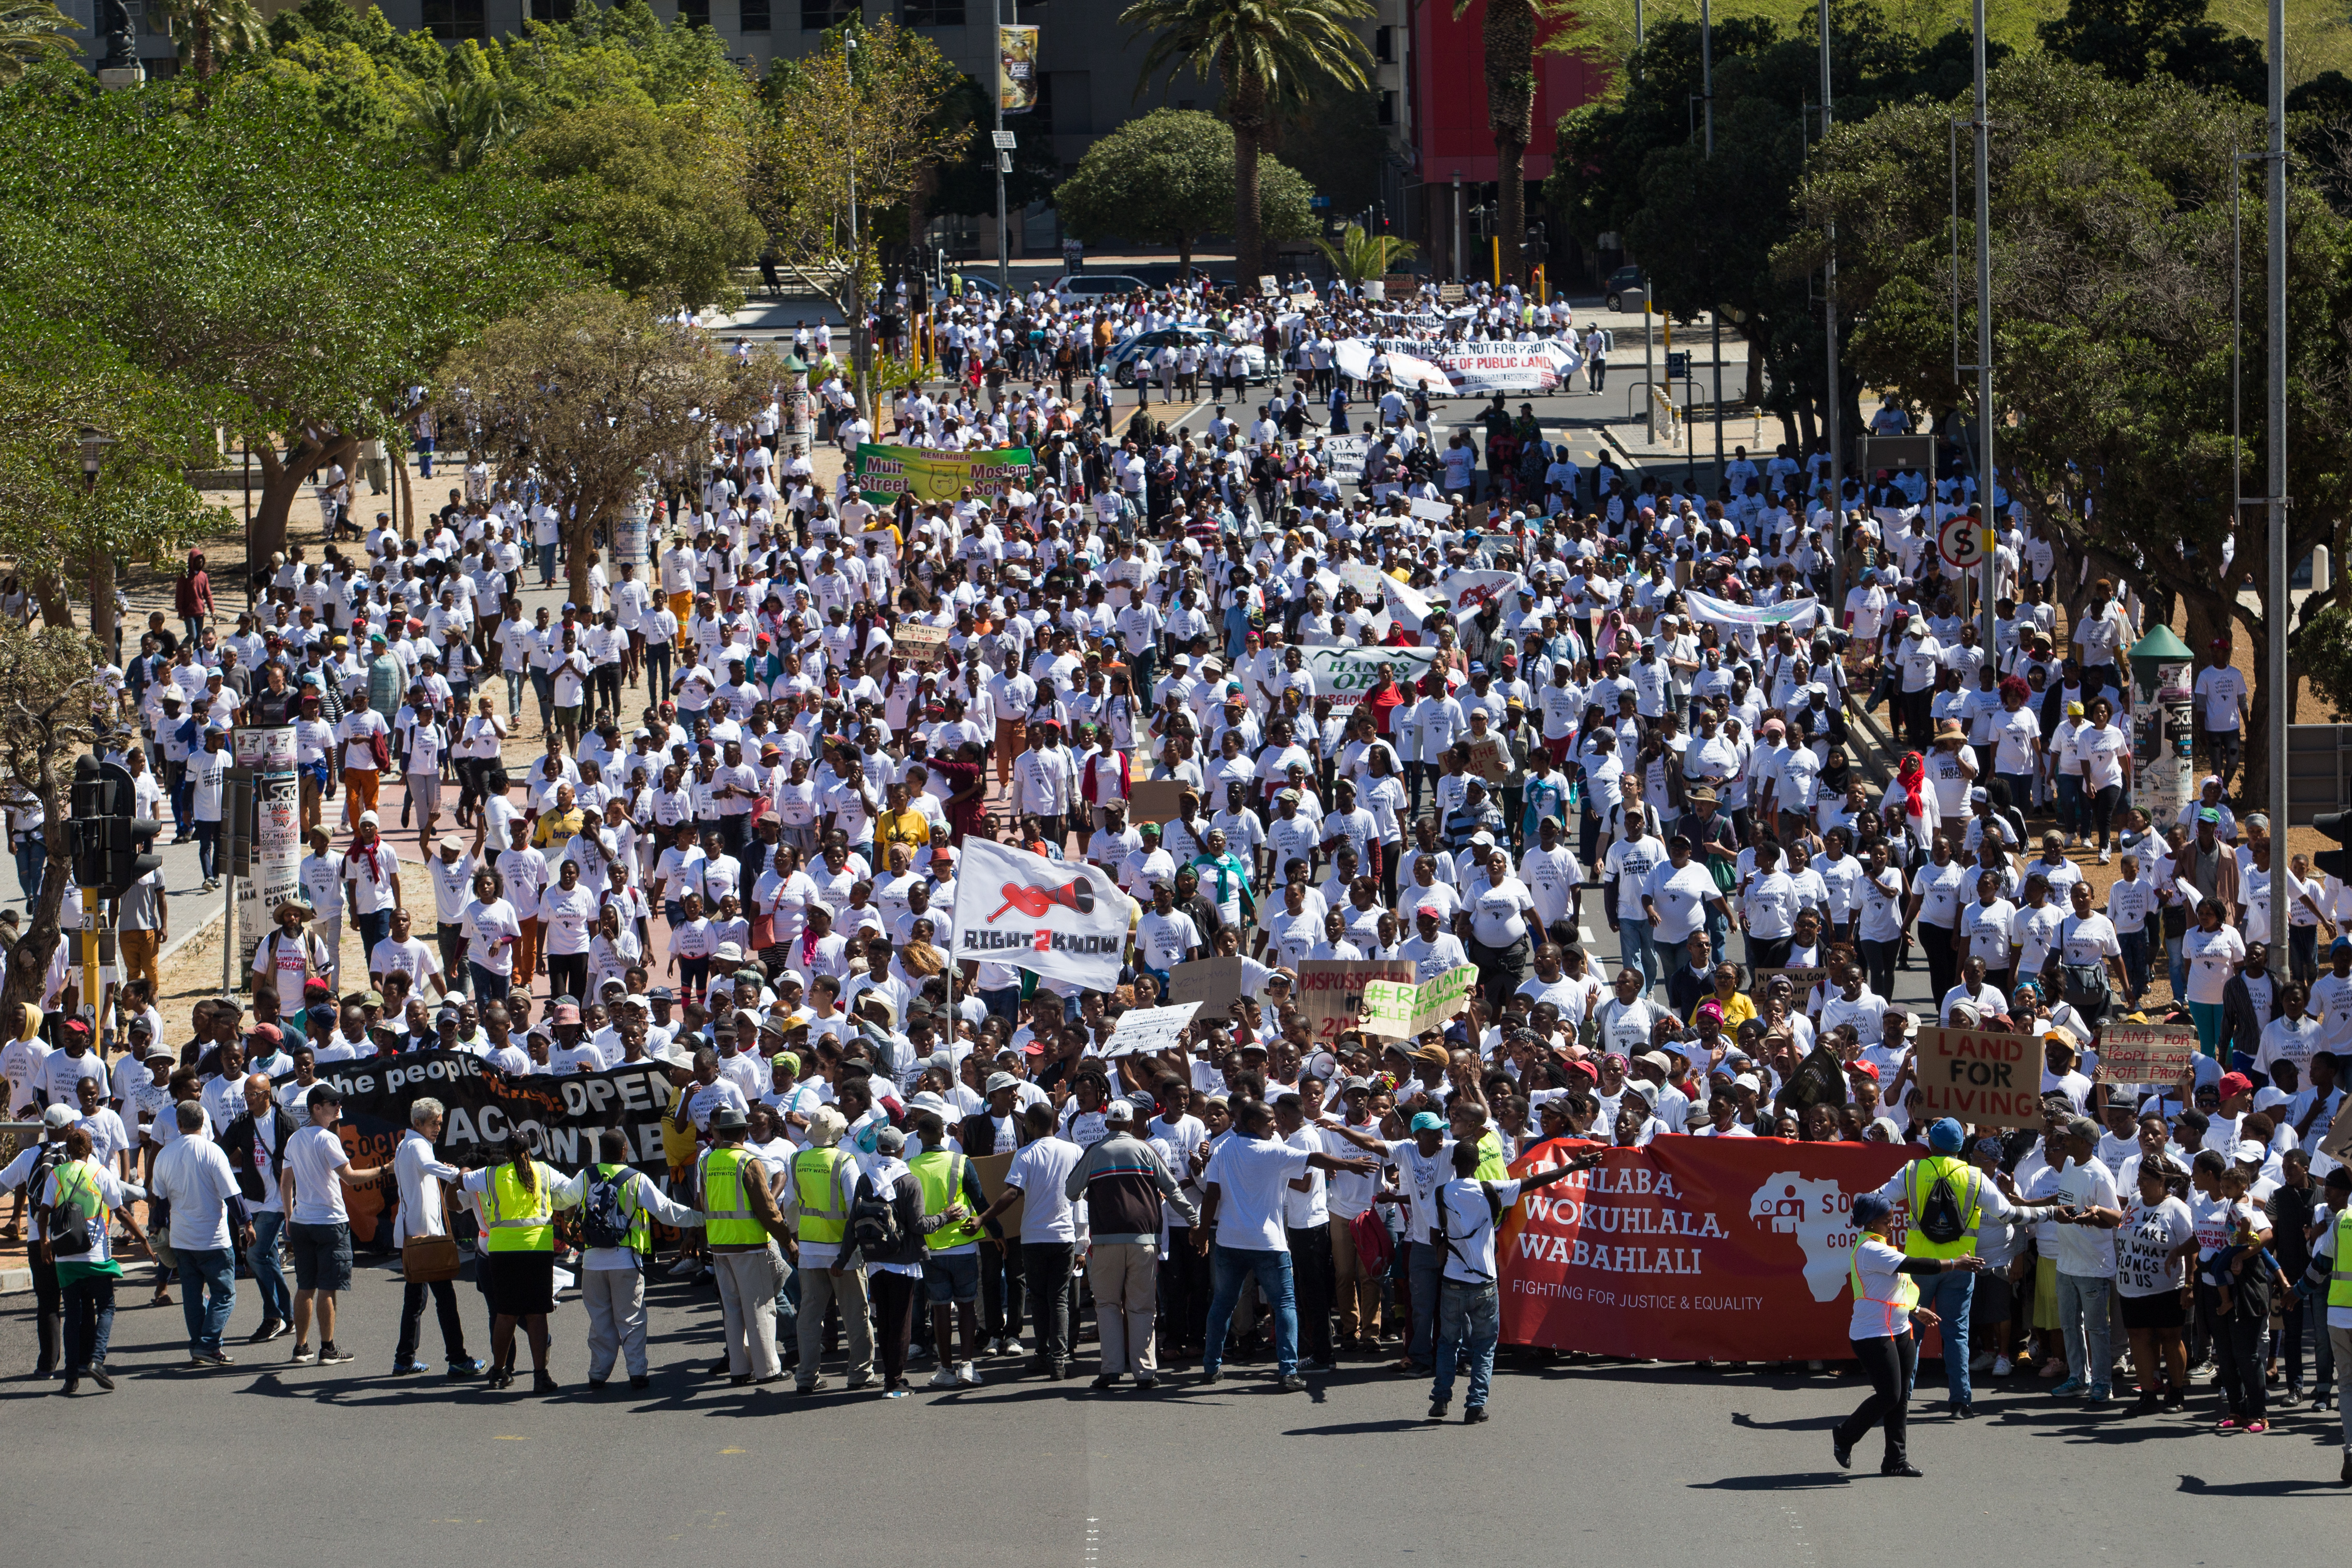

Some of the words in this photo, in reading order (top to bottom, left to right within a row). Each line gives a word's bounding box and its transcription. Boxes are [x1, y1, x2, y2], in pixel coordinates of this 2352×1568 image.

[1396, 341, 1417, 354] FOR
[1469, 343, 1490, 354] NOT
[1495, 342, 1515, 354] FOR
[1459, 358, 1473, 369] OF
[1478, 357, 1517, 368] PUBLIC
[1671, 355, 1680, 366] P
[920, 451, 971, 461] REMEMBER
[866, 457, 904, 474] Muir
[970, 463, 1030, 479] Moslem
[1339, 464, 1352, 472] AT
[859, 474, 909, 493] Street
[1954, 529, 1975, 556] S
[896, 650, 940, 658] TODAY
[266, 803, 293, 812] JAPAN
[273, 819, 290, 828] DAY
[552, 829, 572, 839] bnz
[1624, 865, 1650, 873] PEOPLE
[264, 881, 297, 895] DEFENDING
[85, 916, 90, 927] 2
[963, 928, 1119, 955] RIGHT2KNOW
[1365, 966, 1478, 1006] #RECLAIM
[2109, 1029, 2155, 1044] LAND
[2164, 1033, 2190, 1046] FOR
[1939, 1032, 2023, 1061] LAND
[385, 1054, 482, 1094] people
[1951, 1059, 2012, 1088] FOR
[2105, 1066, 2138, 1079] FOR
[1927, 1085, 2032, 1117] LIVING
[1524, 1195, 1730, 1239] WOKUHLALA,
[2142, 1211, 2160, 1222] WE
[2133, 1226, 2169, 1243] TAKE
[1517, 1232, 1702, 1274] WABAHLALI
[2132, 1241, 2169, 1258] WHAT
[2119, 1271, 2130, 1285] TO
[2135, 1274, 2153, 1288] US
[1512, 1279, 1583, 1300] FIGHTING
[1588, 1289, 1615, 1305] FOR
[1619, 1293, 1676, 1310] JUSTICE
[1679, 1296, 1690, 1309] &
[1694, 1296, 1763, 1311] EQUALITY
